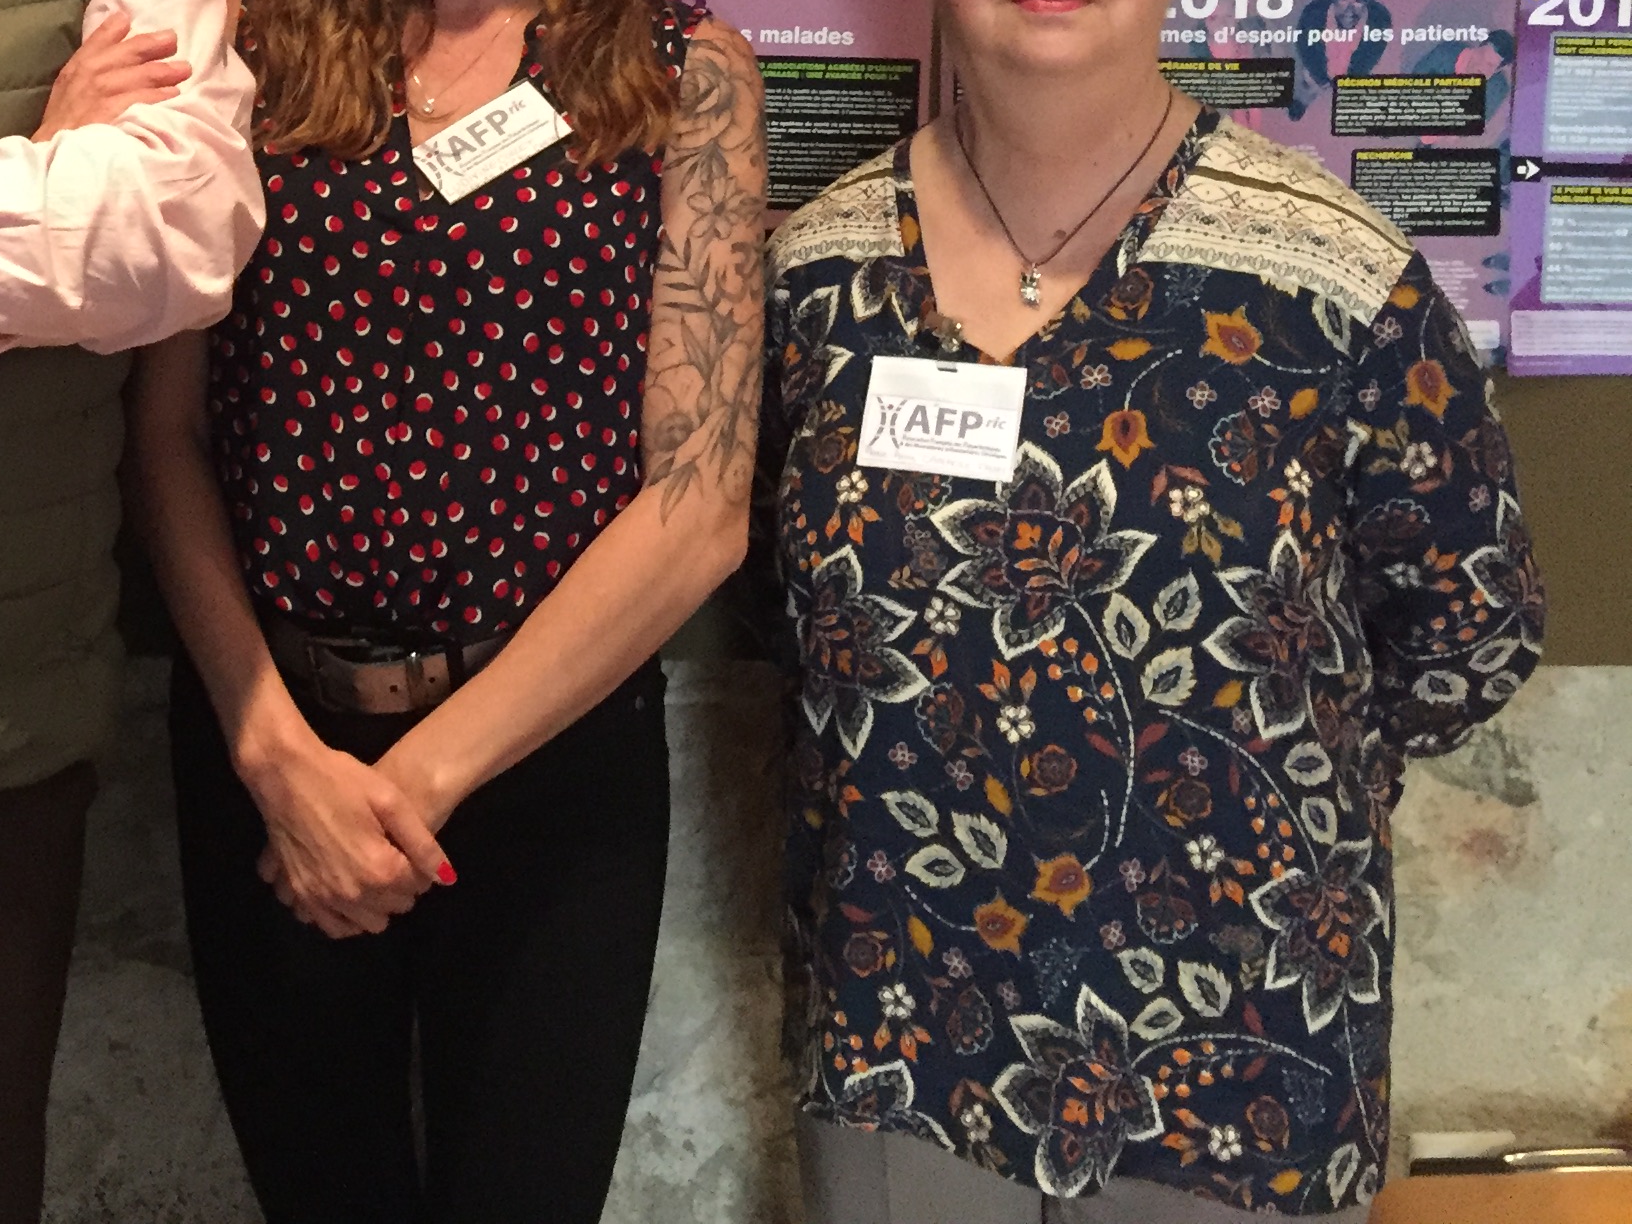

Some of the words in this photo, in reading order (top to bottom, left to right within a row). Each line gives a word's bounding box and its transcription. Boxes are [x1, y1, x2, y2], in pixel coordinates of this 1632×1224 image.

[759, 27, 854, 46] malades
[1213, 26, 1303, 46] d'espoir
[1308, 26, 1357, 45] pour
[1363, 25, 1394, 42] les
[1401, 24, 1490, 45] patients
